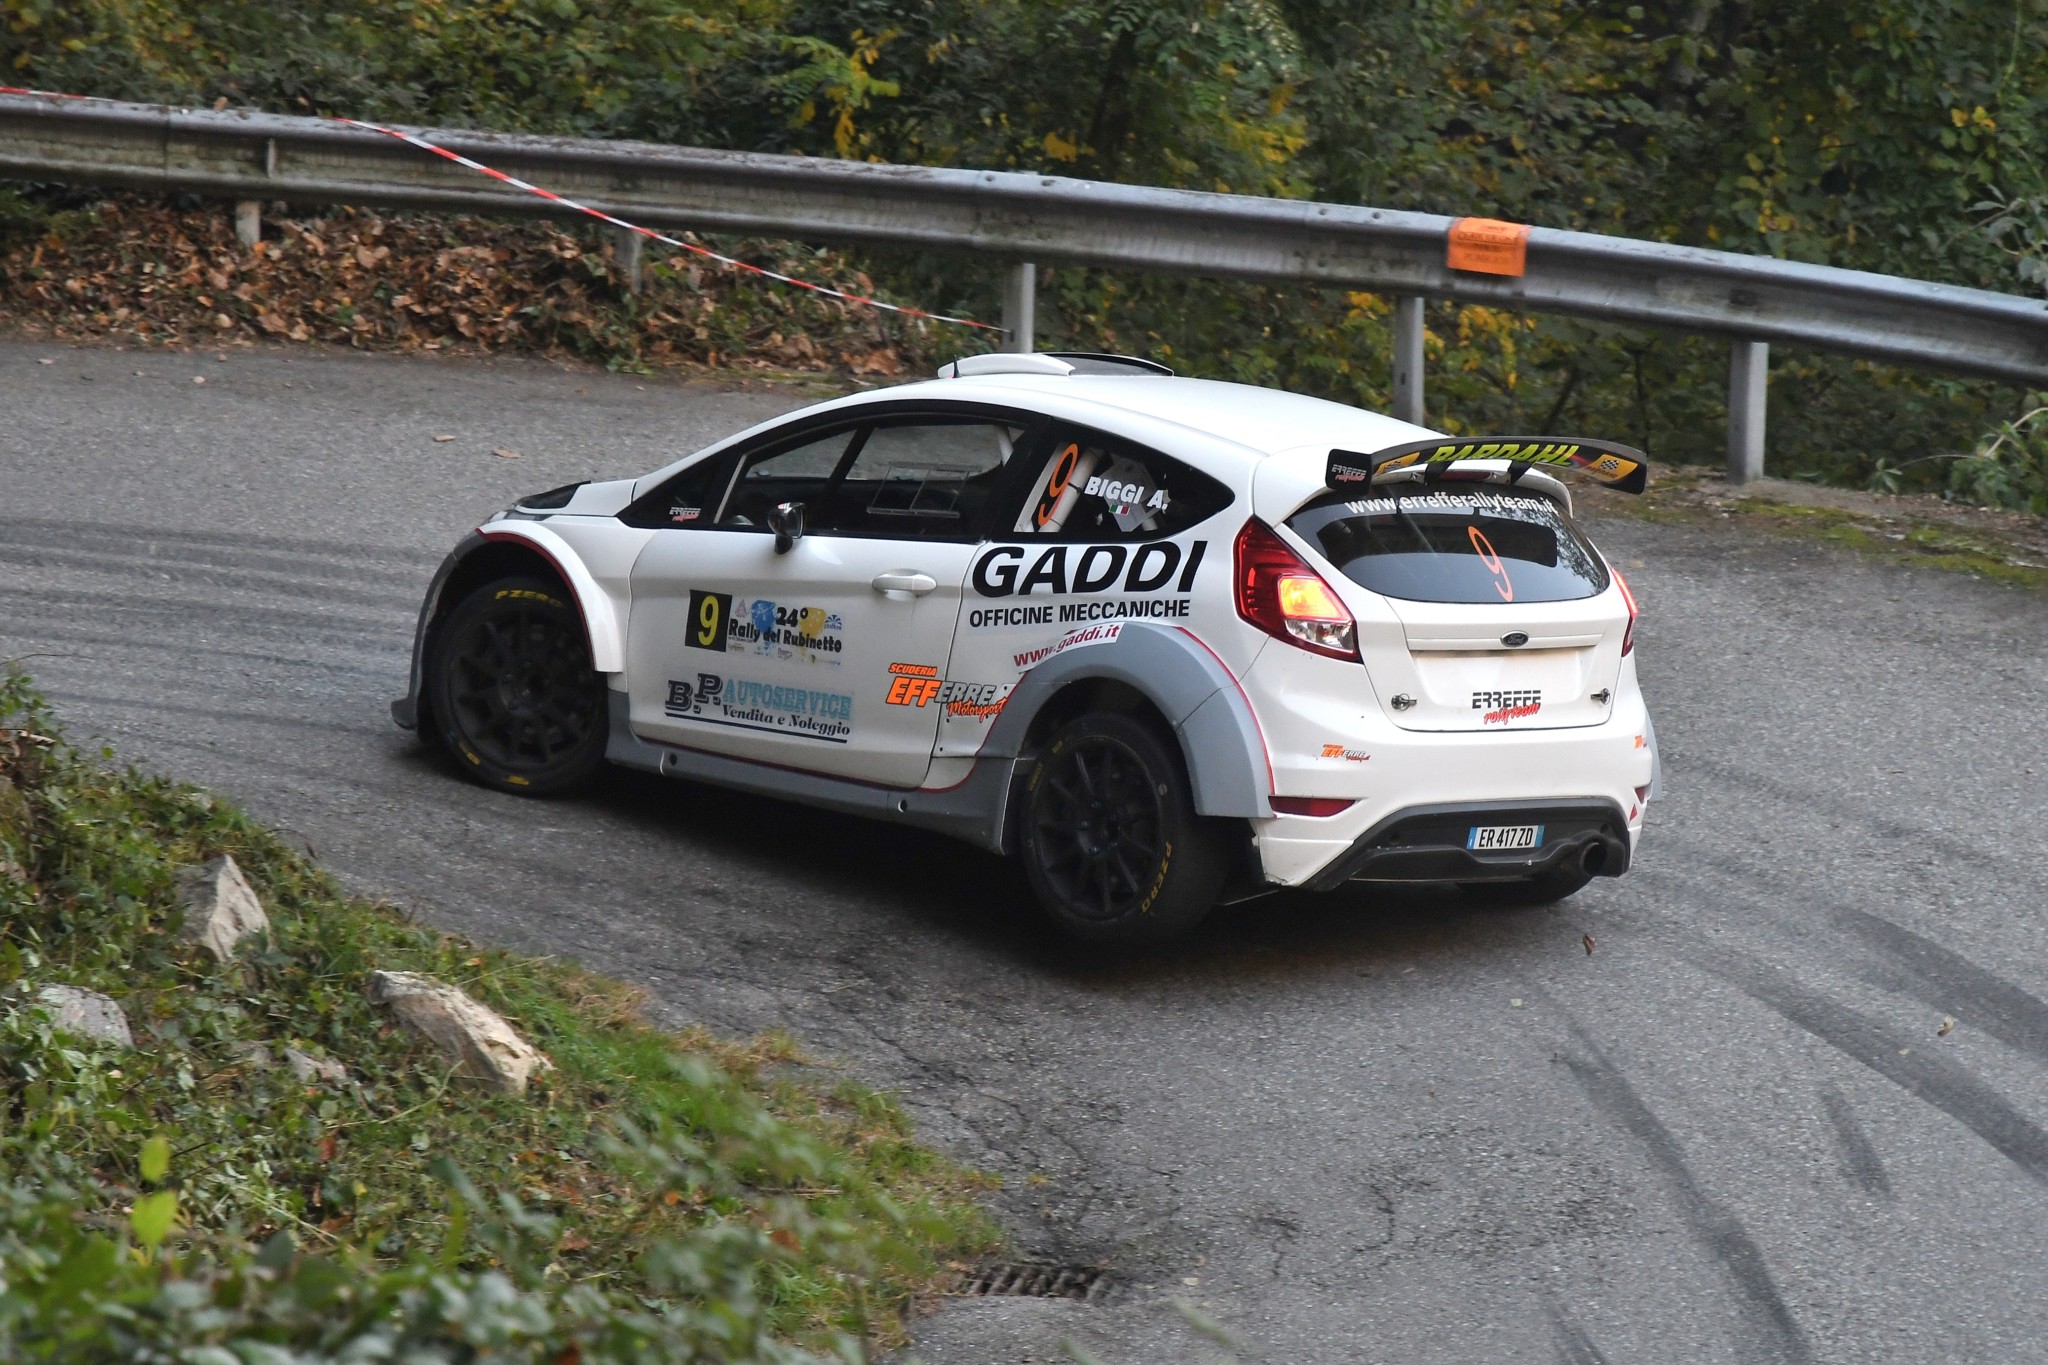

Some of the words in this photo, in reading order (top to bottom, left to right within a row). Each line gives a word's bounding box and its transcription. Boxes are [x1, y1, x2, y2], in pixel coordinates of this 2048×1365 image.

[1038, 443, 1079, 527] 9
[1084, 476, 1144, 504] BIGGI
[1147, 489, 1168, 510] A.
[1344, 492, 1558, 515] www.errefferallyteam.it
[972, 540, 1208, 597] GADDI
[1468, 526, 1513, 602] 9
[699, 595, 719, 646] 9
[970, 606, 1053, 627] OFFICINE
[1059, 599, 1190, 622] MECCANICHE
[728, 618, 760, 643] Rally
[763, 627, 780, 643] del
[783, 630, 842, 653] Rubinetto
[889, 662, 938, 677] SCUDERIA
[723, 679, 852, 720] AUTOSERVICE
[723, 704, 773, 724] Vendita
[777, 716, 785, 725] e
[789, 714, 850, 737] Noleggio
[1479, 828, 1495, 848] ER
